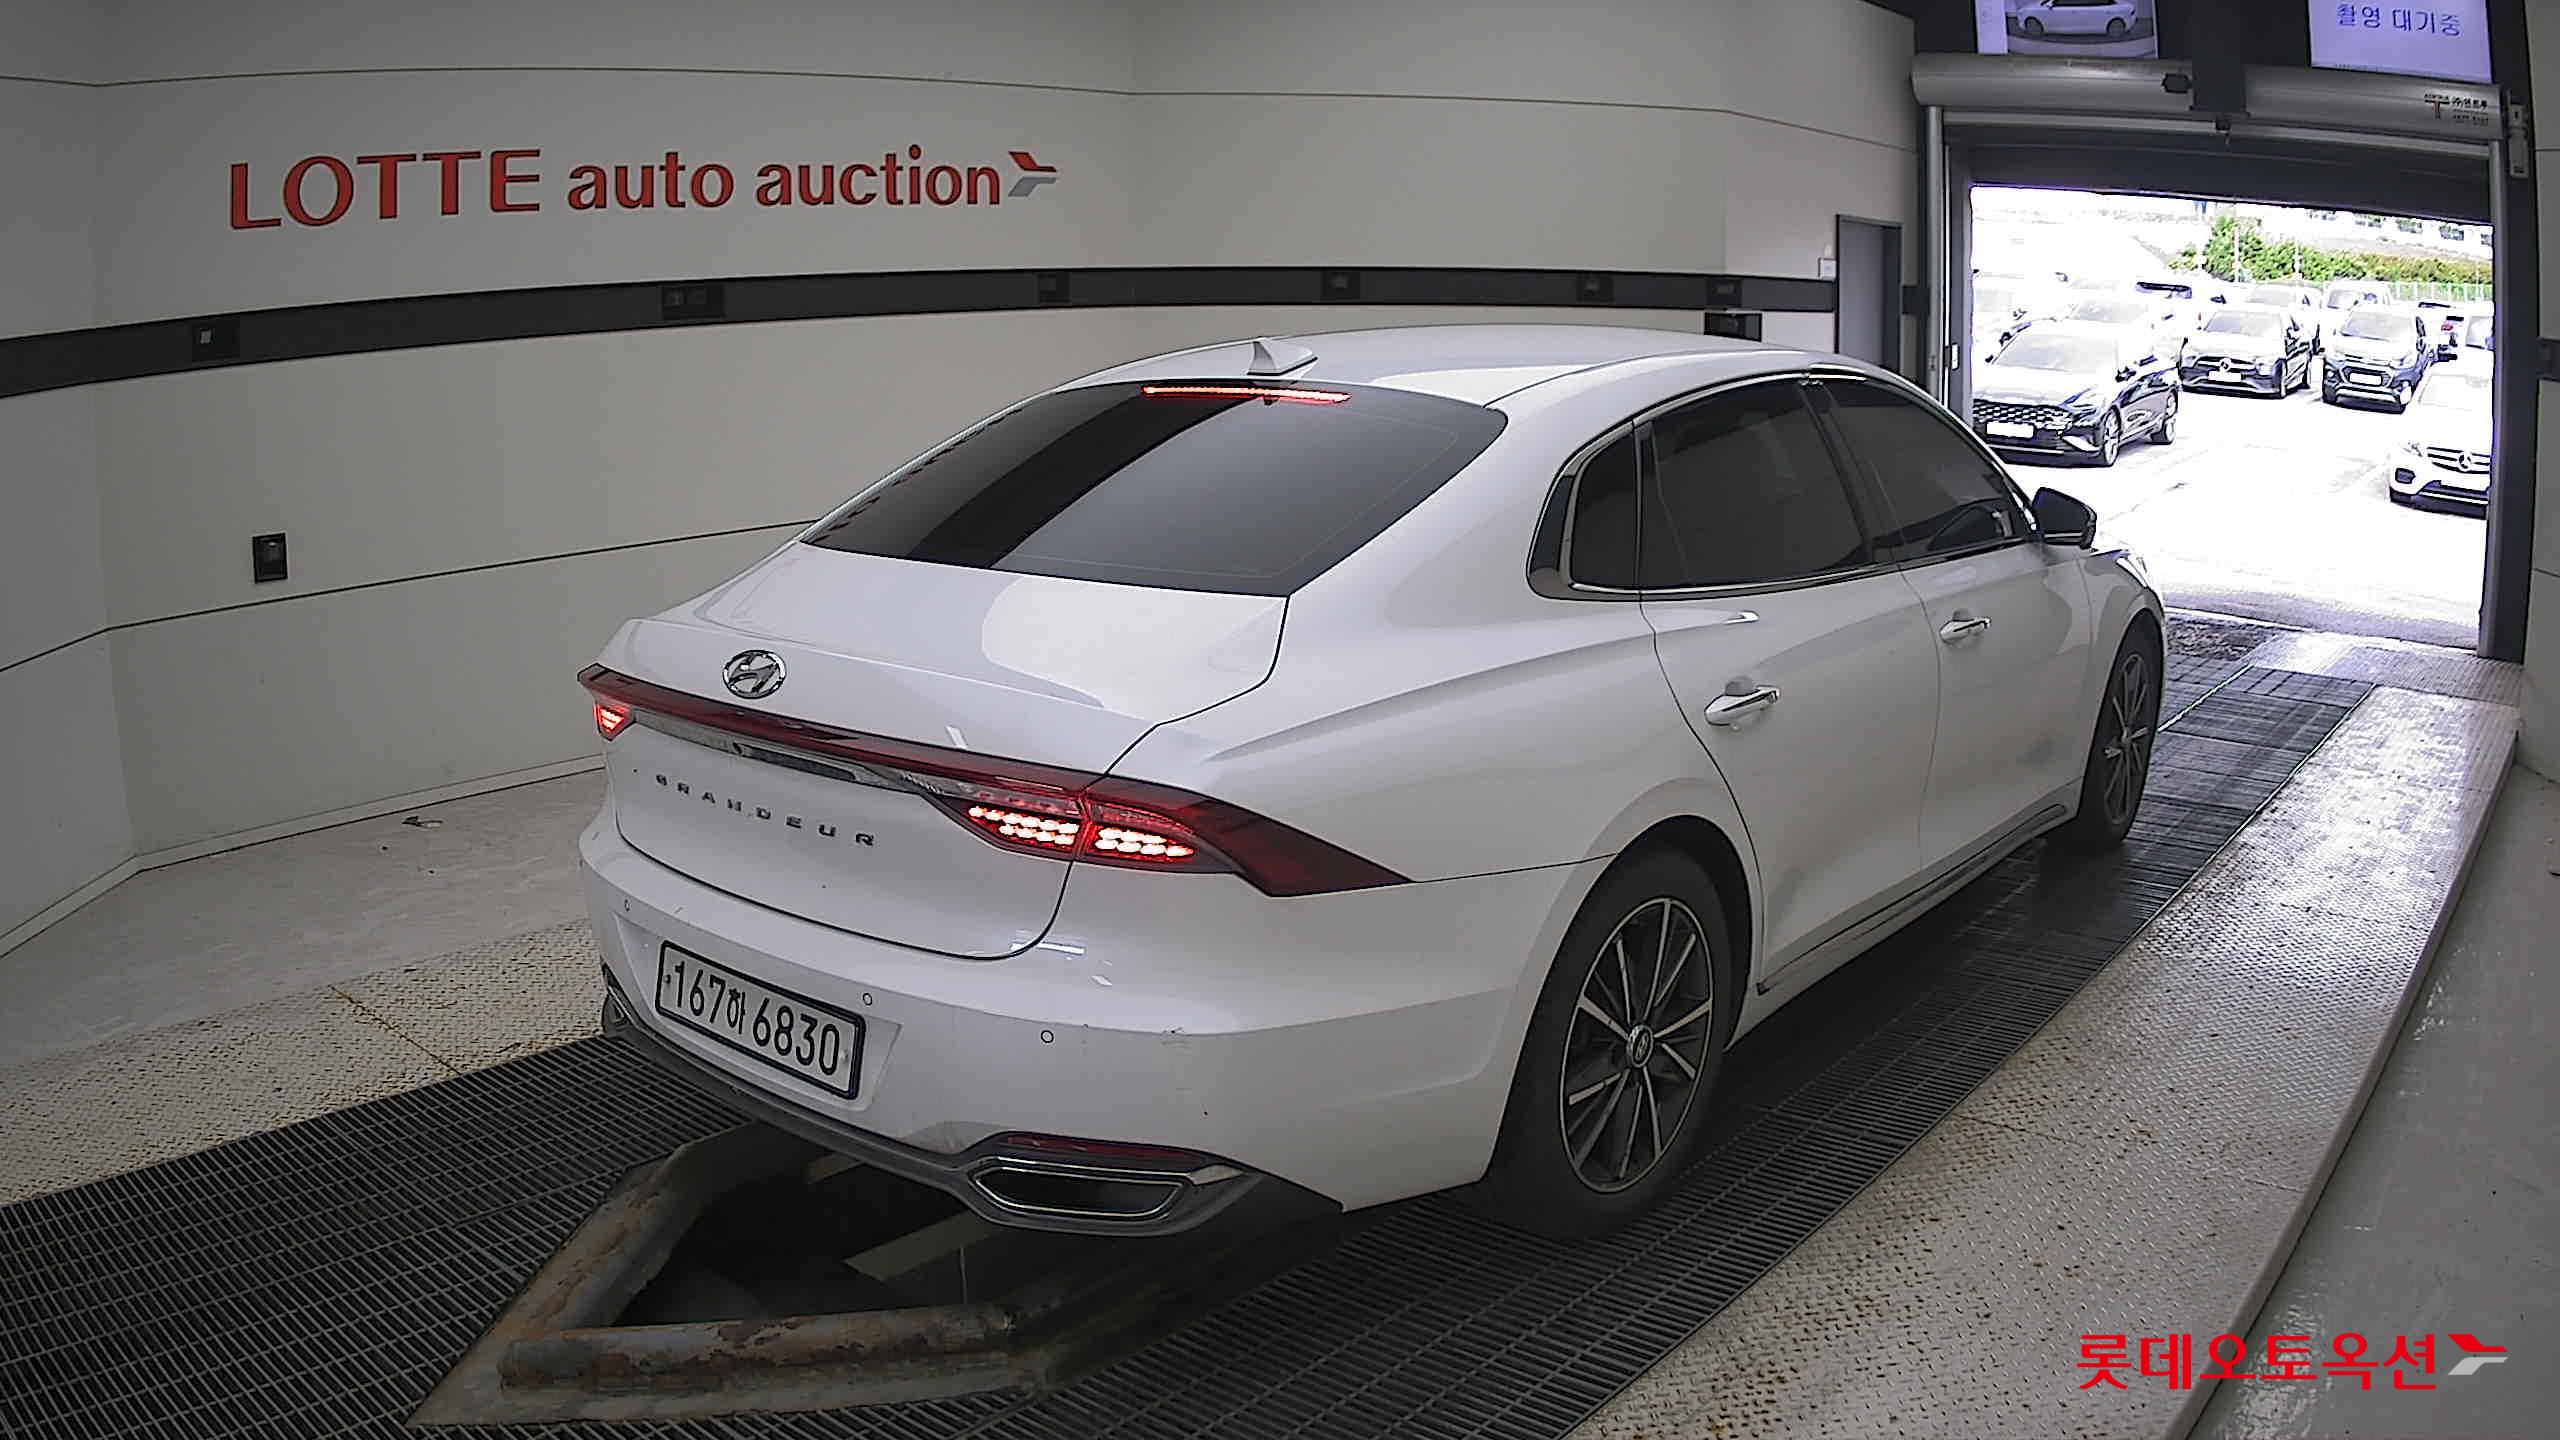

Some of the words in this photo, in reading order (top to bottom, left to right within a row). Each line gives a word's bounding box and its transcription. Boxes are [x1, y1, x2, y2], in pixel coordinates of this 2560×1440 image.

[2337, 3, 2381, 29] 촬영
[2392, 8, 2461, 37] 대기중
[230, 149, 541, 229] LOTTE
[567, 151, 735, 210] auto
[755, 144, 1001, 208] auction
[655, 773, 875, 847] GRANDEUR
